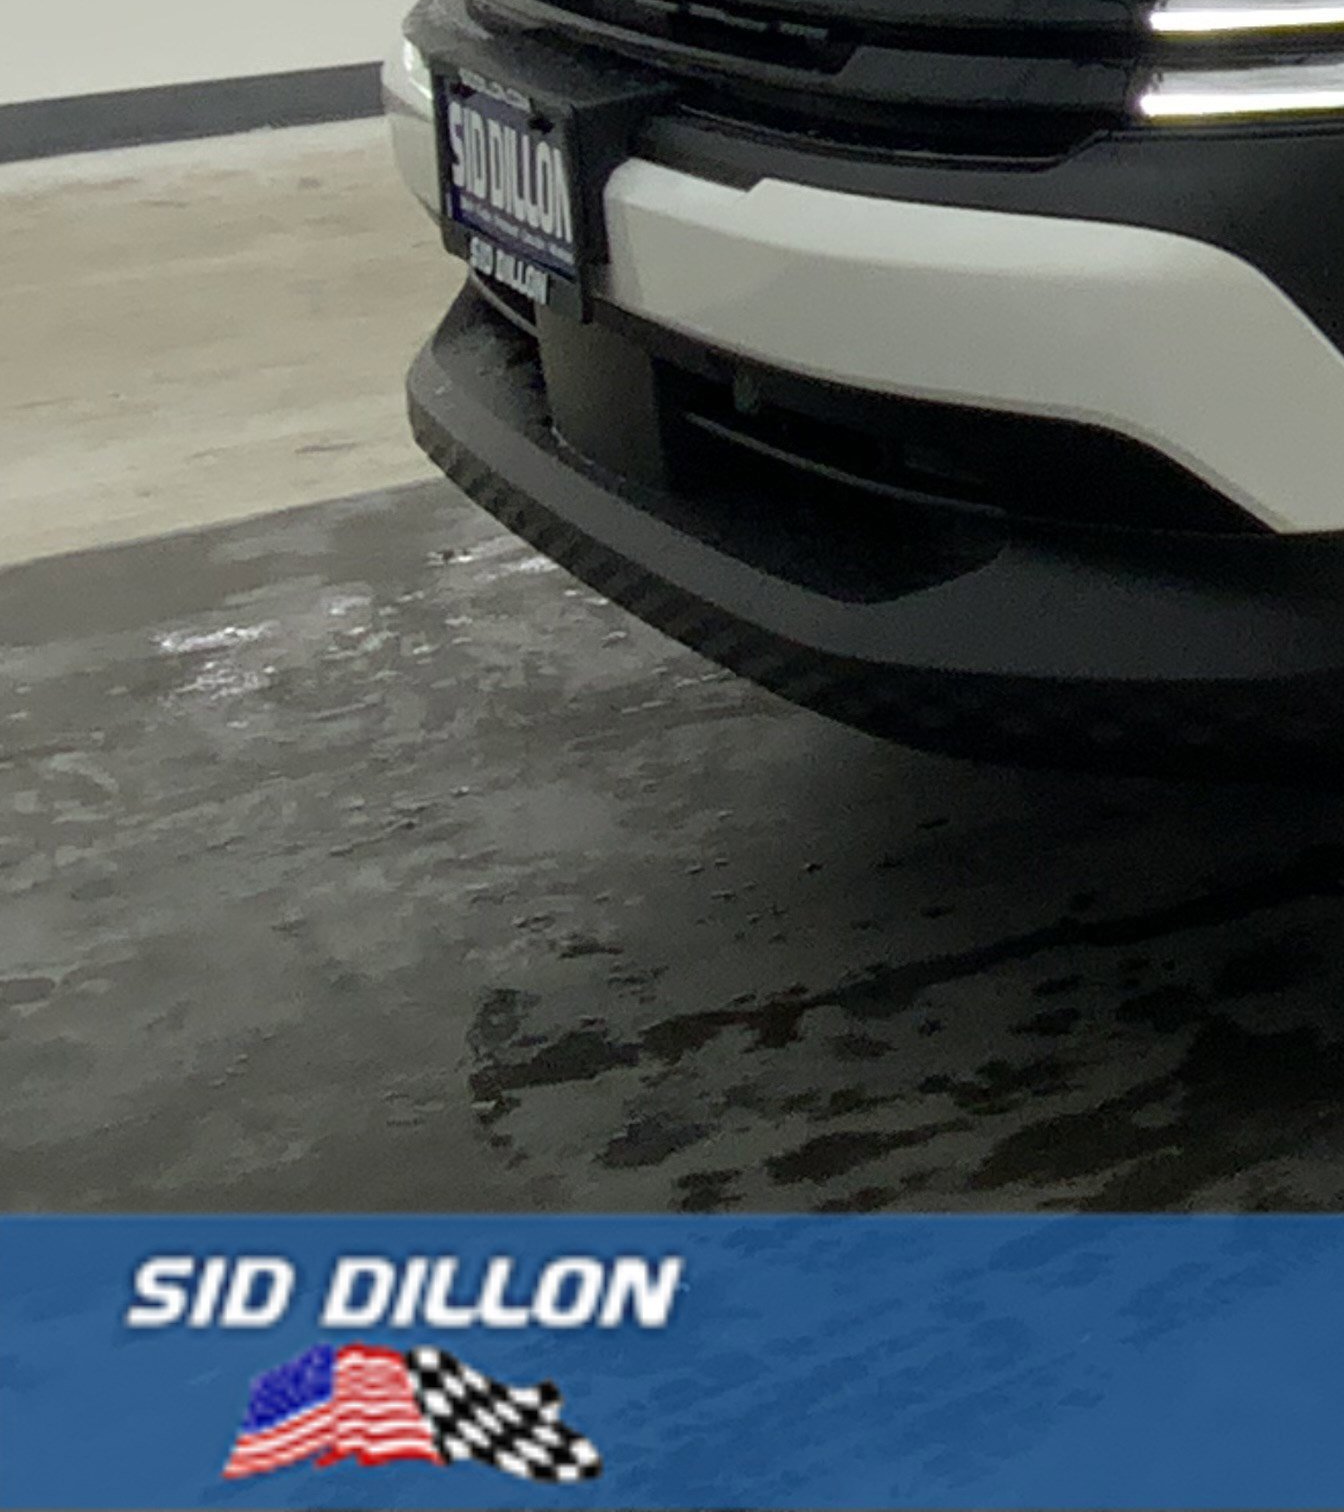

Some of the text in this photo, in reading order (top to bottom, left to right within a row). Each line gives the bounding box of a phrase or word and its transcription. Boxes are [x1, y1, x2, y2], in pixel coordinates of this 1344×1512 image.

[448, 100, 487, 200] SID
[487, 117, 574, 245] DILLON
[495, 247, 548, 306] DILLON
